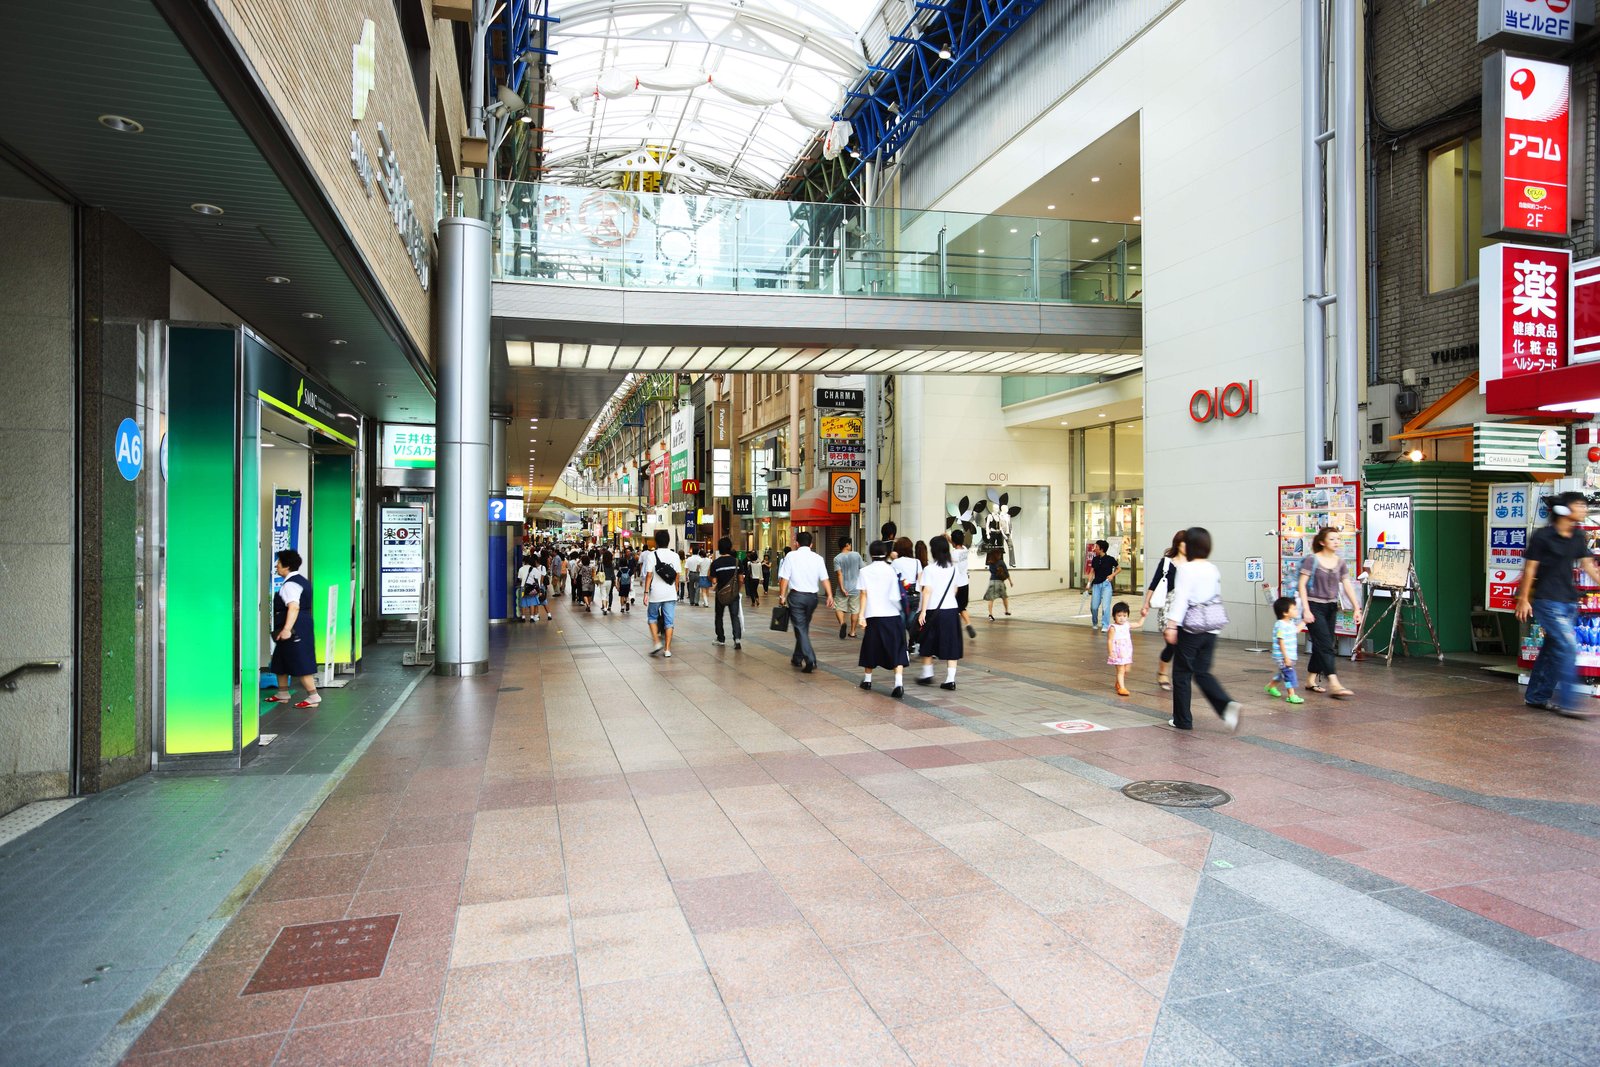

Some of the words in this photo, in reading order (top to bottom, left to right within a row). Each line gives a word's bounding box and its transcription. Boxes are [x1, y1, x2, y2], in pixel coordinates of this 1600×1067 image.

[1505, 9, 1570, 36] 当ビル2F
[1508, 133, 1561, 162] アコム
[1526, 212, 1544, 228] 2F
[1512, 259, 1558, 320] 薬
[1512, 321, 1558, 339] 健康食品
[1512, 339, 1558, 357] 化粧品
[1512, 357, 1557, 372] ヘルシーフード
[304, 388, 318, 411] SMBC
[824, 390, 856, 401] CHARMA
[117, 431, 141, 466] A6
[1488, 456, 1512, 464] CHARMA
[736, 498, 749, 509] GAP
[771, 493, 788, 507] GAP
[1496, 491, 1525, 504] 杉本
[1373, 502, 1409, 511] CHARMA
[1495, 505, 1525, 519] 歯科
[1388, 511, 1409, 519] HAIR
[1492, 529, 1526, 546] 賃貸
[1372, 548, 1406, 564] CHARMA
